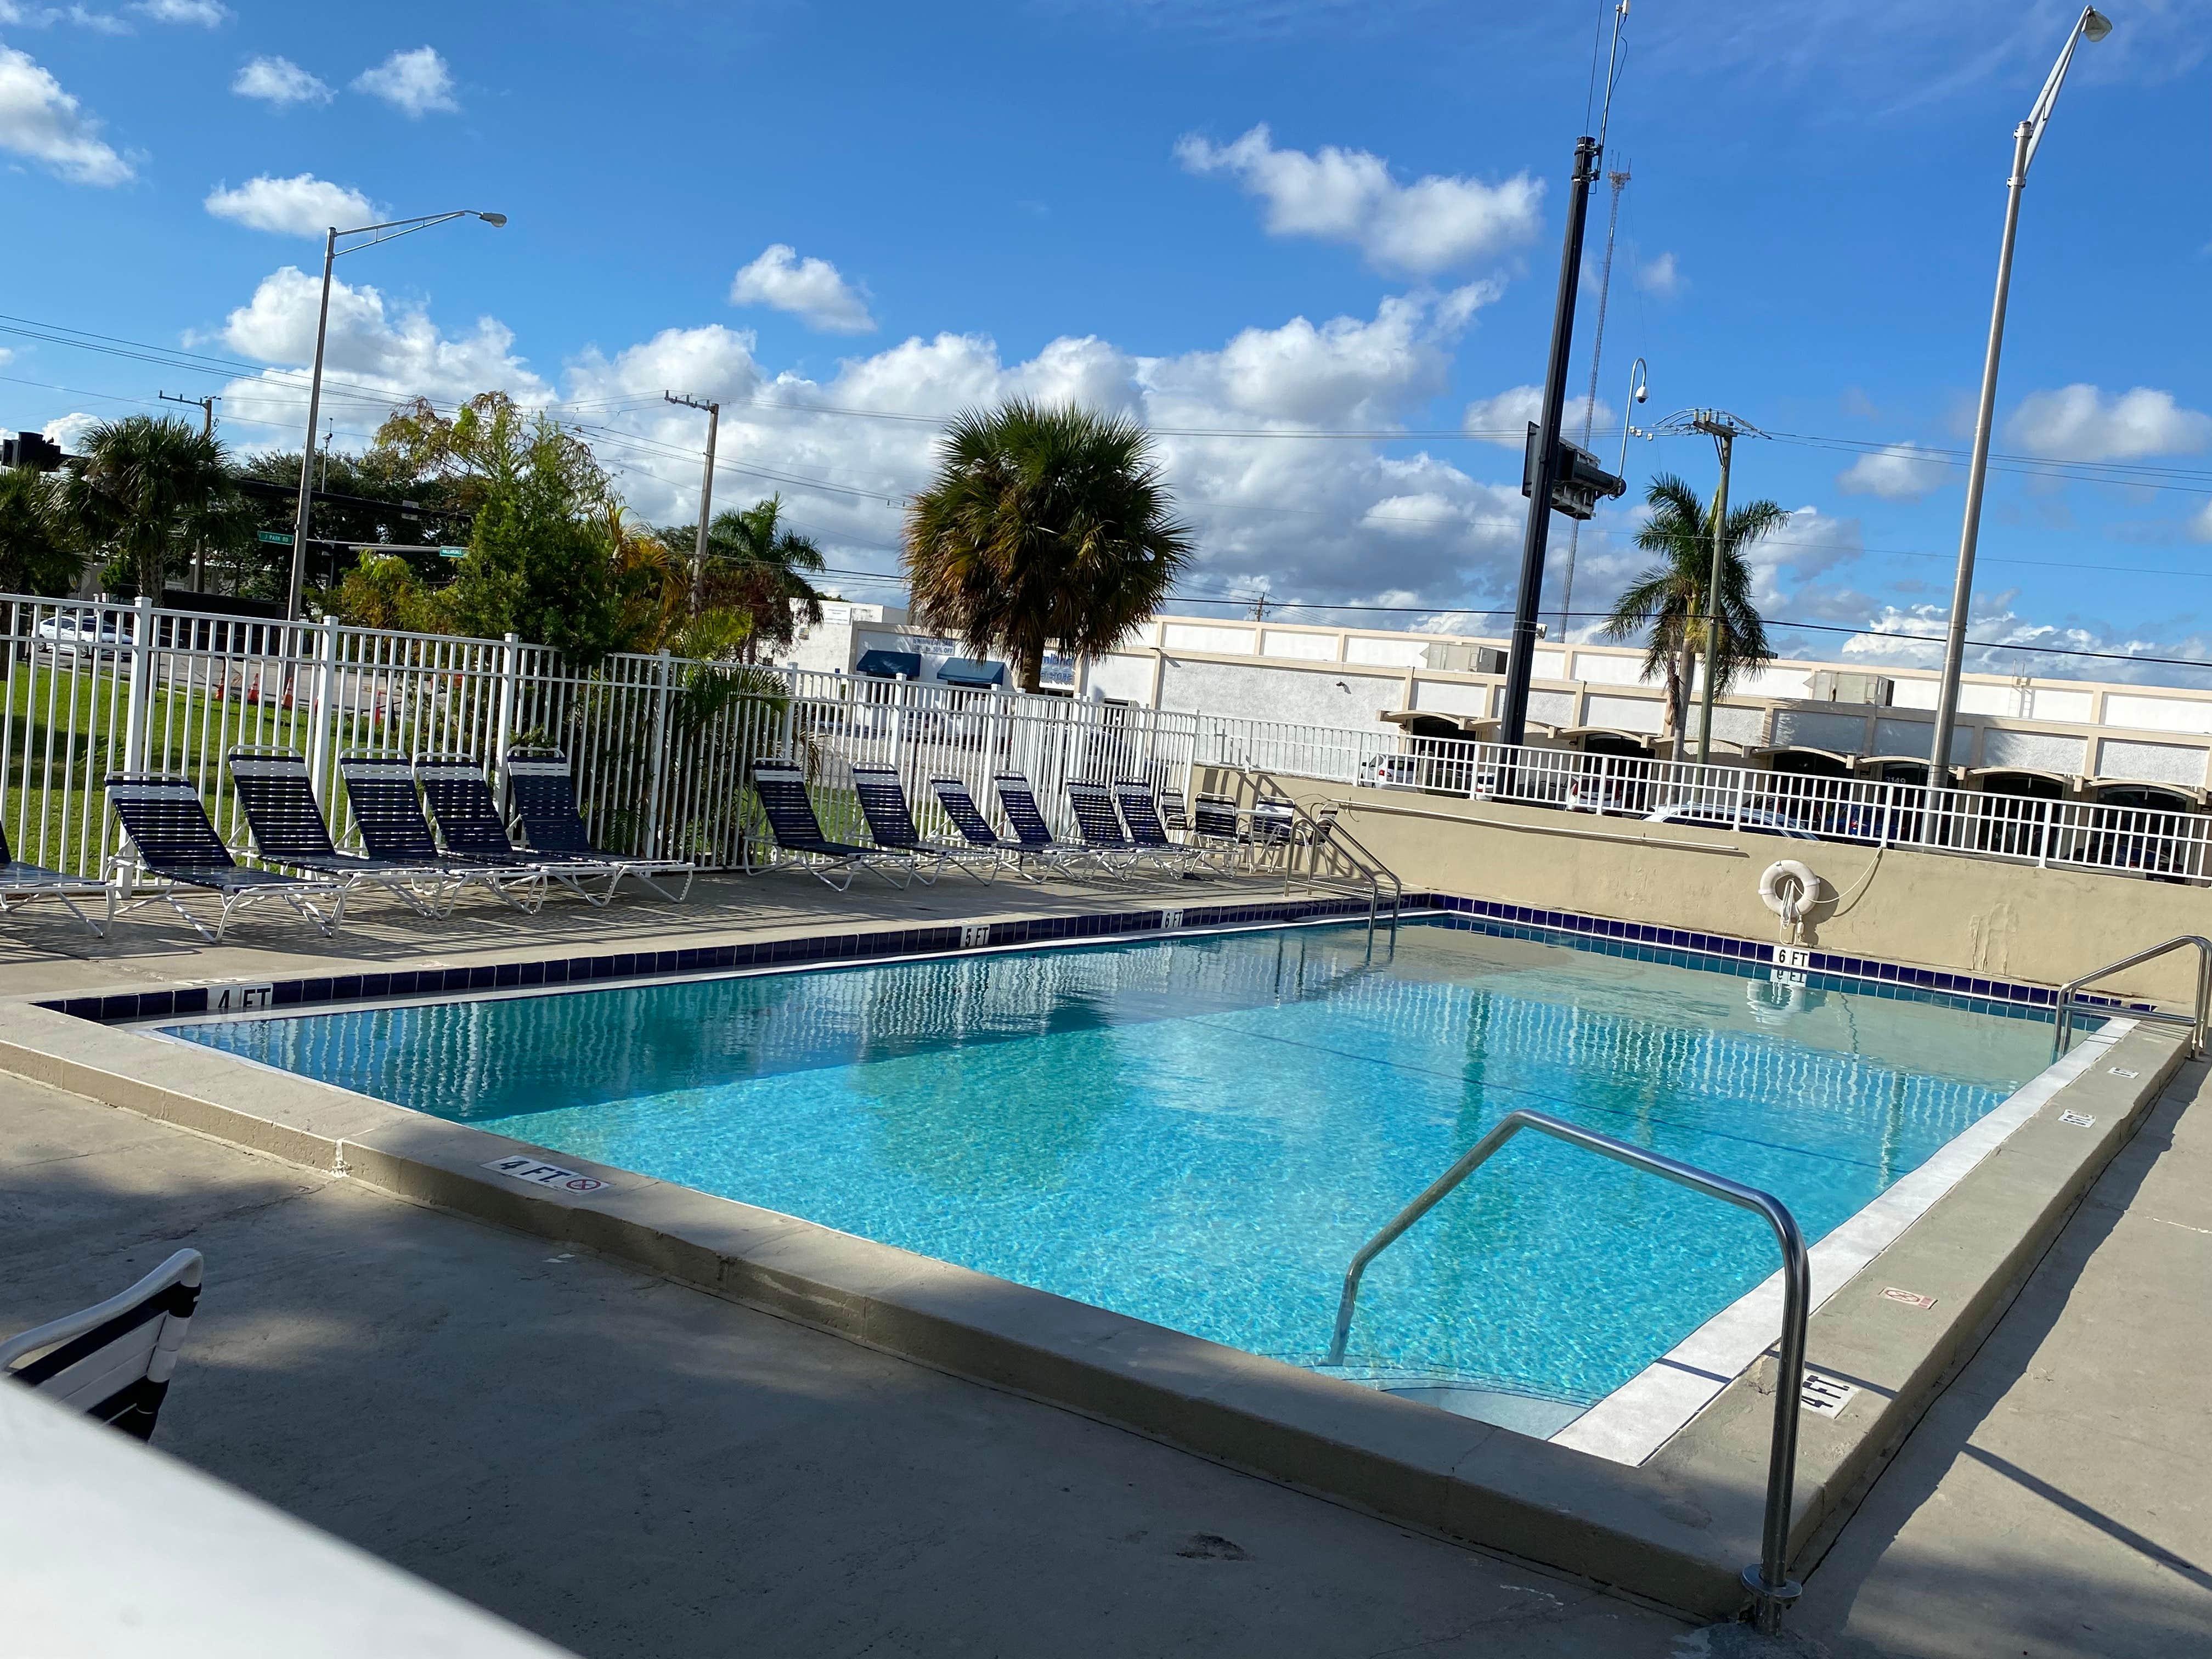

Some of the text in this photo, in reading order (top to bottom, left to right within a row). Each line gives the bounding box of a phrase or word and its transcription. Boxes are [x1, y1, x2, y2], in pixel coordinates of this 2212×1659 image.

[1048, 672, 1073, 682] STORE
[1165, 911, 1183, 929] 6 FT
[965, 927, 989, 947] 5 FT
[1779, 949, 1809, 967] 6 FT
[218, 988, 272, 1008] 4 FT
[499, 1160, 530, 1170] 4
